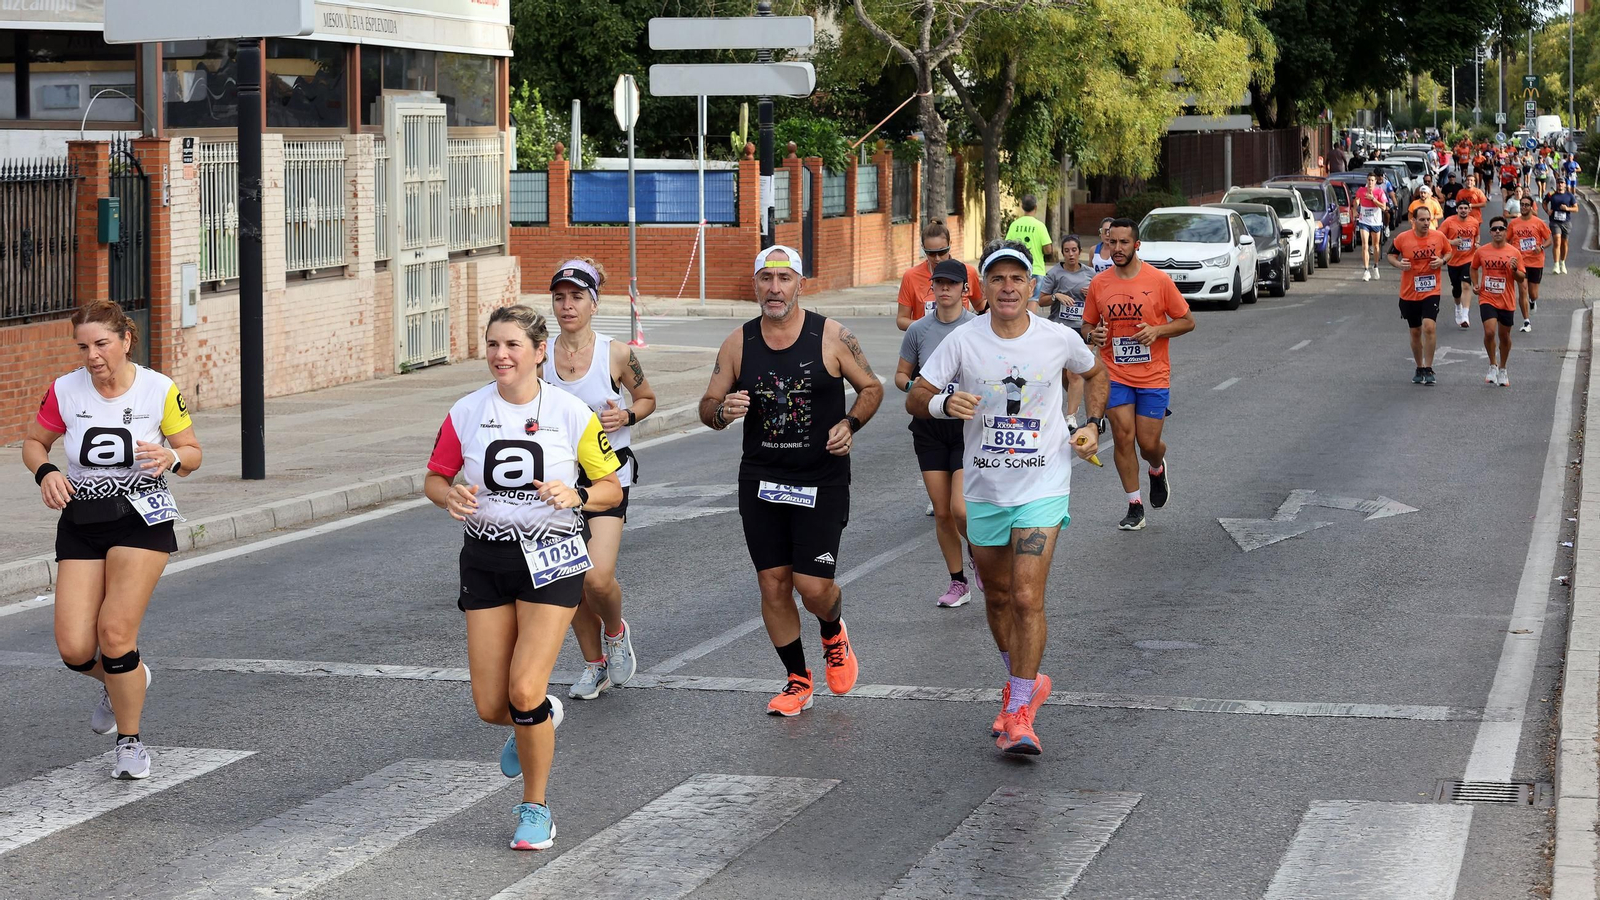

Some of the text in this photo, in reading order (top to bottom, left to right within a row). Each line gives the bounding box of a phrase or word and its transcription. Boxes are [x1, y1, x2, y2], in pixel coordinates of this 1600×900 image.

[323, 12, 343, 28] MESON
[365, 17, 398, 34] ESPLENDIDA
[1015, 225, 1036, 234] STAFF
[1412, 248, 1437, 259] XXIX
[1484, 260, 1508, 269] XXIX
[1065, 306, 1079, 314] 868
[1107, 302, 1143, 318] XXIX
[1121, 345, 1141, 356] 978
[761, 440, 779, 449] PABLO
[994, 431, 1026, 447] 884
[973, 456, 1001, 469] PABLO
[538, 540, 580, 568] 1036
